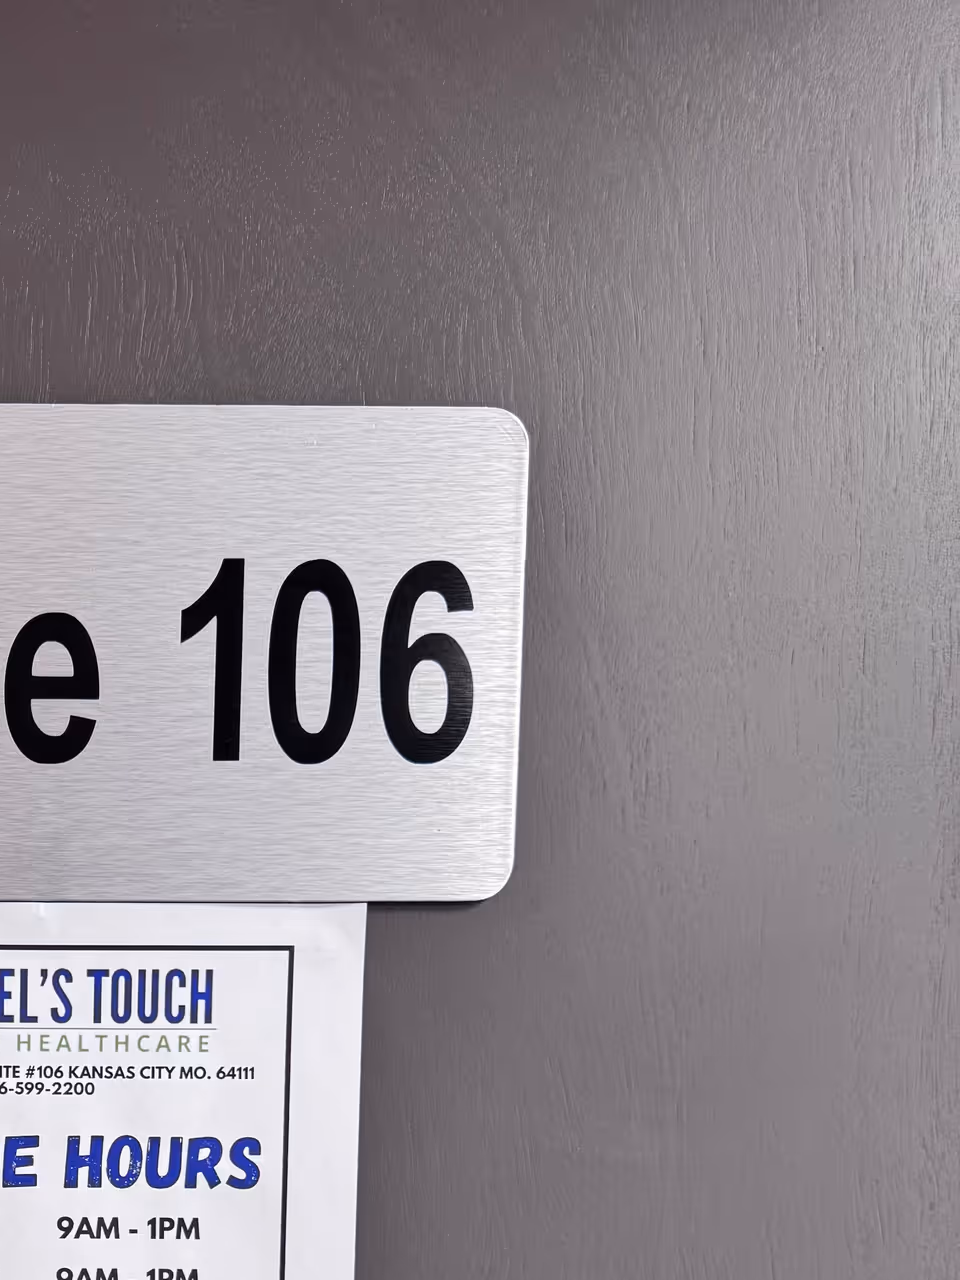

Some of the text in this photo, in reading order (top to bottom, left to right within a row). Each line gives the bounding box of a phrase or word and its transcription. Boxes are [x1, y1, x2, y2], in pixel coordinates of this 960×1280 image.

[181, 558, 474, 764] 106
[87, 968, 213, 1024] TOUCH
[17, 1034, 209, 1052] HEALTHCARE
[26, 1066, 63, 1078] #106
[69, 1066, 135, 1079] KANSAS
[140, 1066, 175, 1079] CITY
[180, 1067, 211, 1079] MO.
[216, 1067, 254, 1079] 64111
[64, 1135, 261, 1189] HOURS
[57, 1216, 119, 1239] 9AM
[147, 1217, 200, 1239] 1PM
